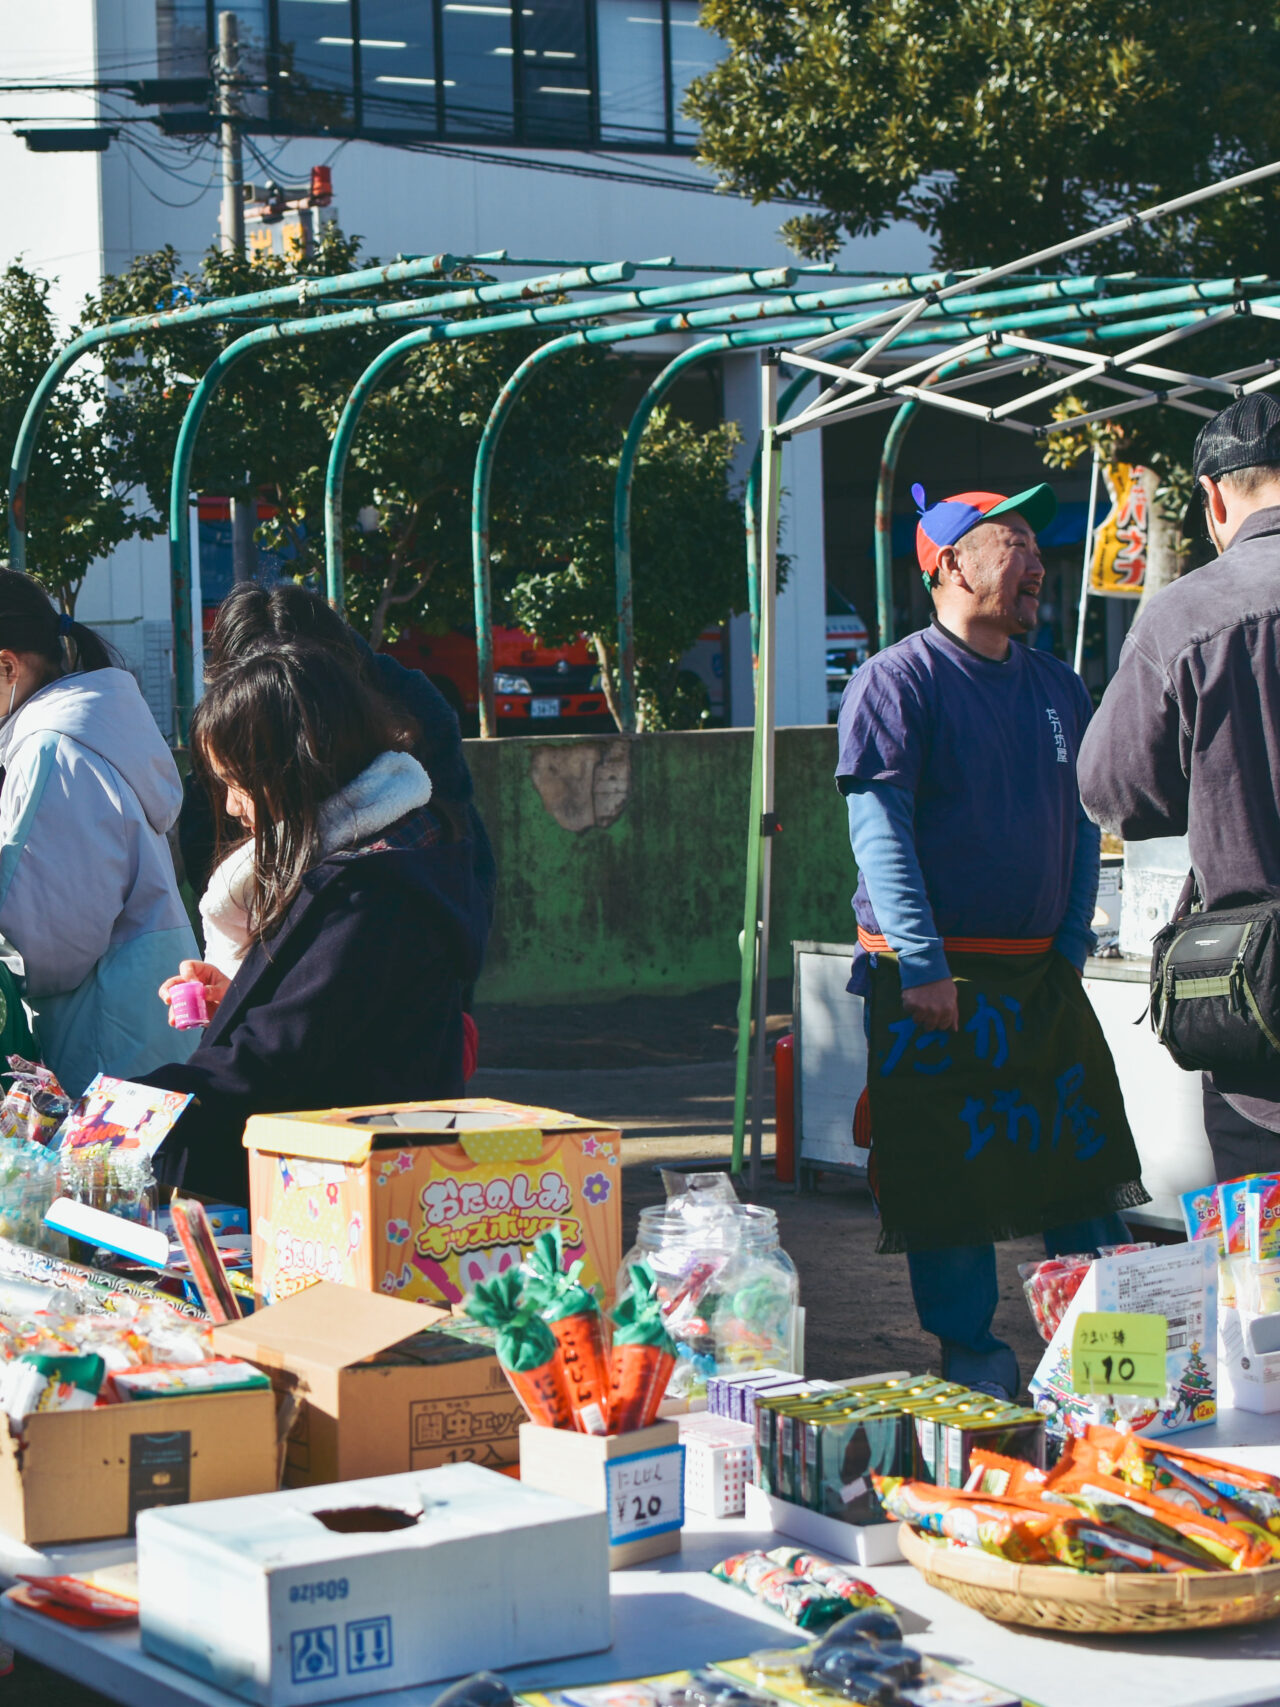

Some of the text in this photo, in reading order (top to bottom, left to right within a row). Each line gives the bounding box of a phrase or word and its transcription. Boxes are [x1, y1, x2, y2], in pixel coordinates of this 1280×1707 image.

[422, 1171, 571, 1225] おたのしみ
[289, 1577, 350, 1605] 60size
